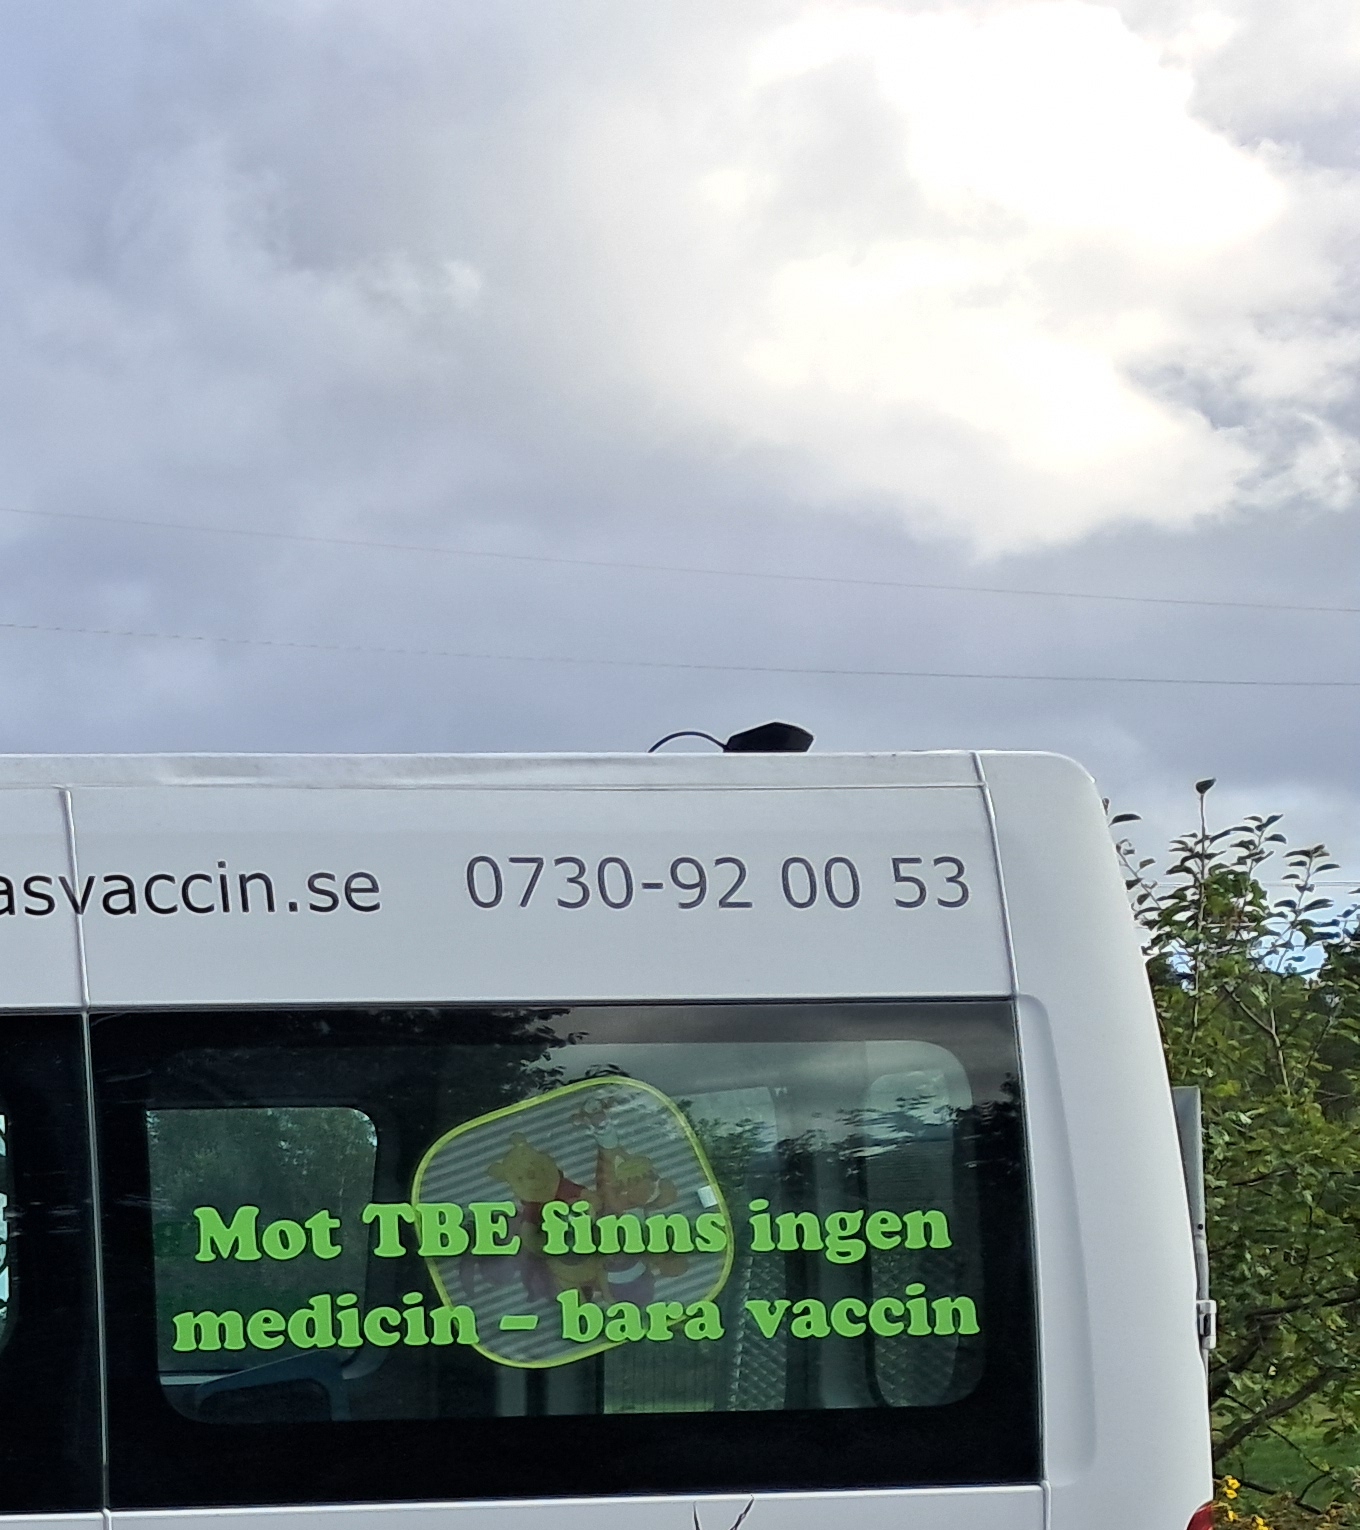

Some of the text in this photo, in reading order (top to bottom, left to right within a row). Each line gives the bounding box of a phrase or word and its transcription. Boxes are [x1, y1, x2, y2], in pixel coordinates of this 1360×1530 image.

[466, 855, 970, 909] 0730-92 00 53
[195, 1195, 951, 1264] Mot TBE finns ingen
[174, 1290, 480, 1352] medicin
[558, 1290, 724, 1343] bara
[746, 1284, 980, 1338] vaccin
